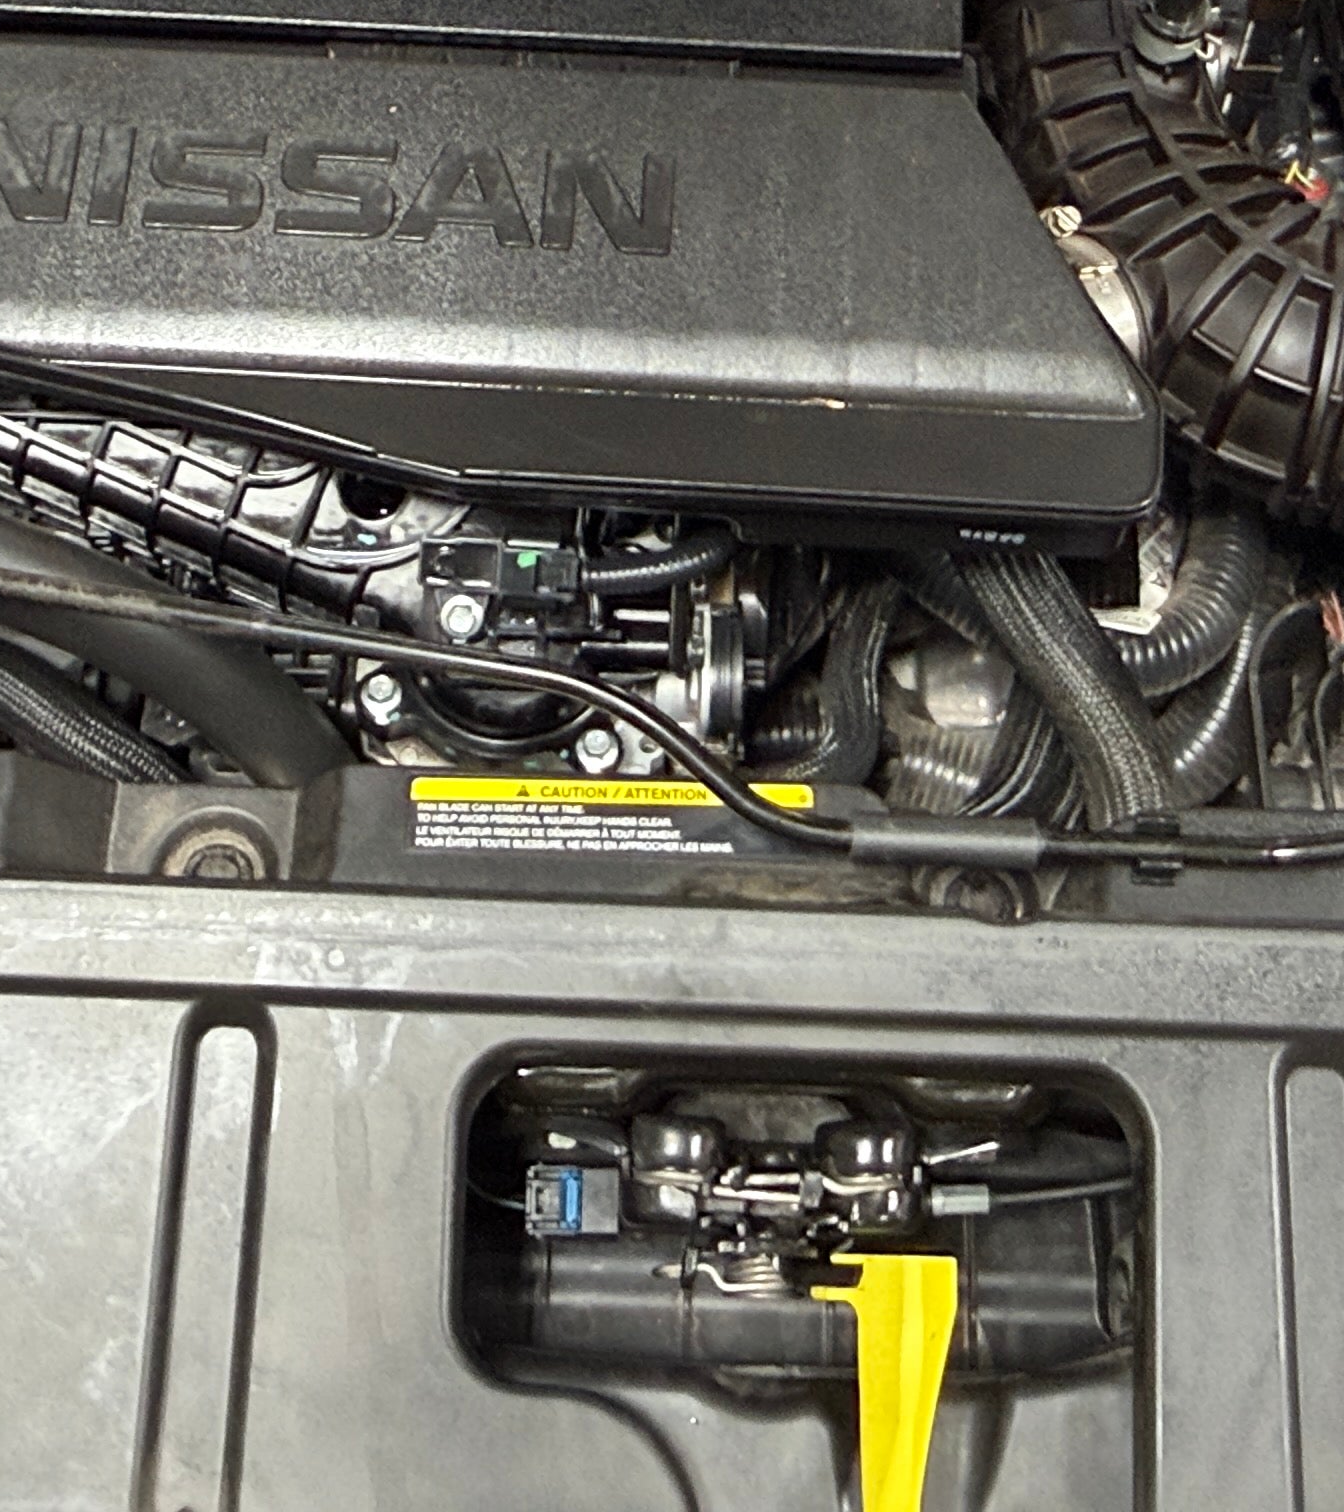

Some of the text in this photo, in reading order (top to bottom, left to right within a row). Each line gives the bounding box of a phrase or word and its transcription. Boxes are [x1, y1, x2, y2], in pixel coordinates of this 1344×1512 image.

[540, 785, 607, 799] CAUTION
[624, 787, 707, 801] ATTENTION
[471, 802, 493, 813] CAN
[494, 803, 524, 813] START
[417, 813, 431, 823] TO
[432, 813, 458, 823] HELP
[458, 814, 489, 824] AVOID
[489, 814, 543, 825] PERSONAL
[602, 816, 637, 826] HANDS
[416, 825, 429, 835] LE
[430, 825, 492, 837] VENTILATEUR
[493, 827, 530, 838] RISQUE
[531, 827, 545, 838] DE
[610, 829, 635, 839] TOUT
[415, 837, 444, 848] POUR
[480, 838, 511, 849] TOUTE
[566, 840, 581, 850] NE
[582, 840, 602, 851] PAS
[603, 840, 618, 851] EN
[618, 841, 679, 851] APPROCHER
[680, 842, 698, 852] LES
